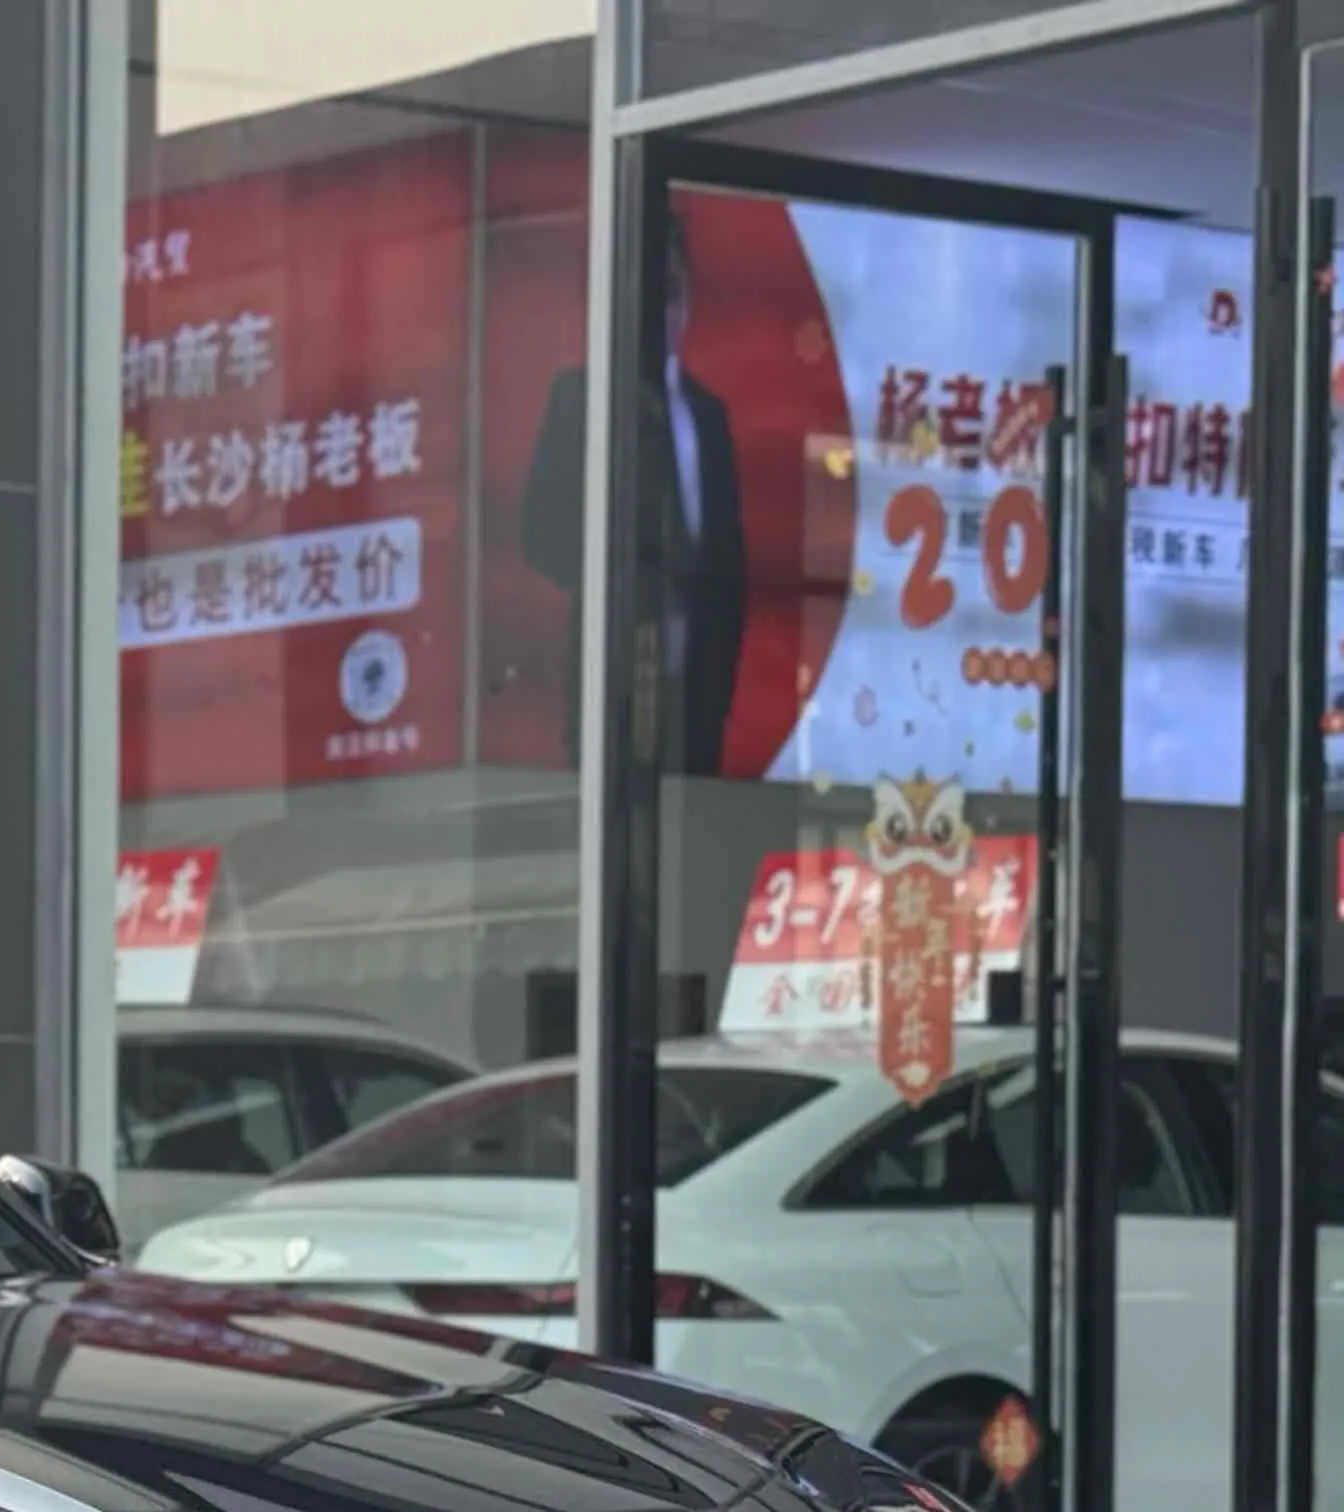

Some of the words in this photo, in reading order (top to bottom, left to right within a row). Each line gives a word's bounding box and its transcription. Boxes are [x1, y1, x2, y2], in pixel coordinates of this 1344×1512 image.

[1125, 394, 1248, 500] 扣特
[136, 533, 405, 633] 也是批发价
